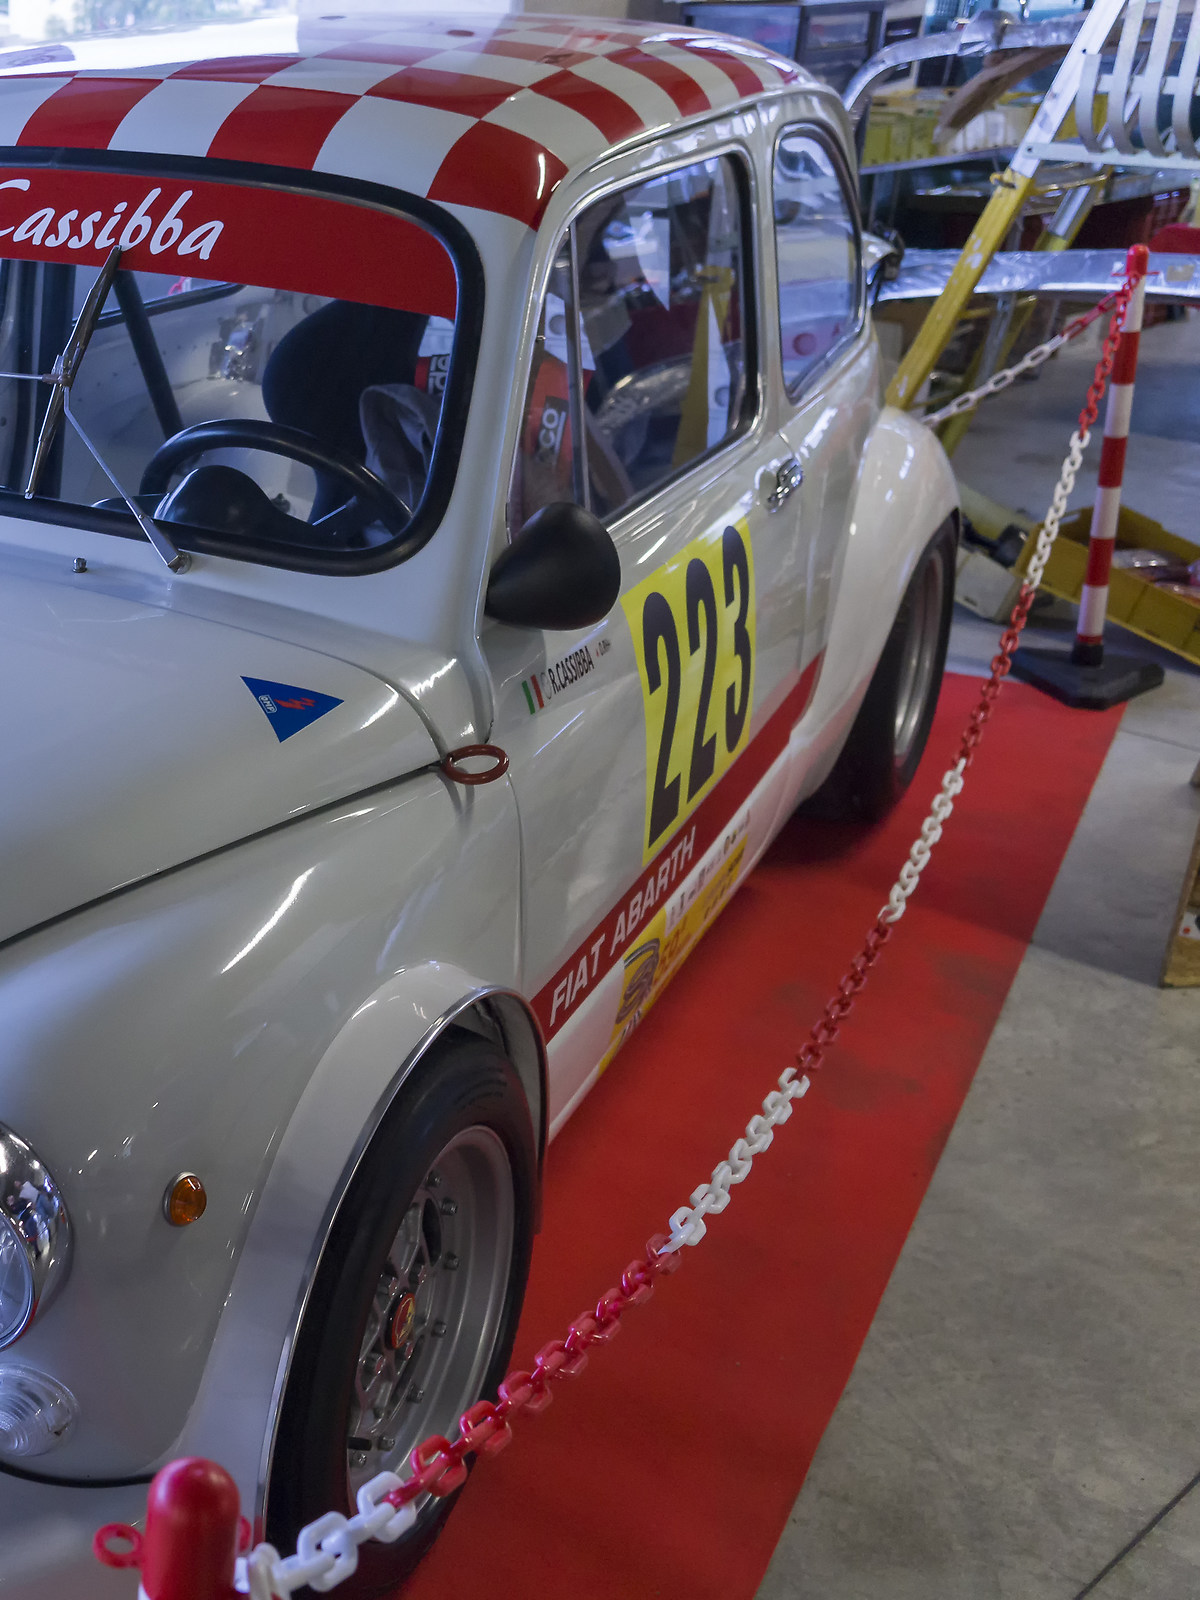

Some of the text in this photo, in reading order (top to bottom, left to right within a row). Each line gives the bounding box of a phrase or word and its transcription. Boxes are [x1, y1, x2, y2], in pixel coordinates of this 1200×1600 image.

[642, 525, 752, 849] 223
[549, 825, 697, 1028] FIAT ABARTH
